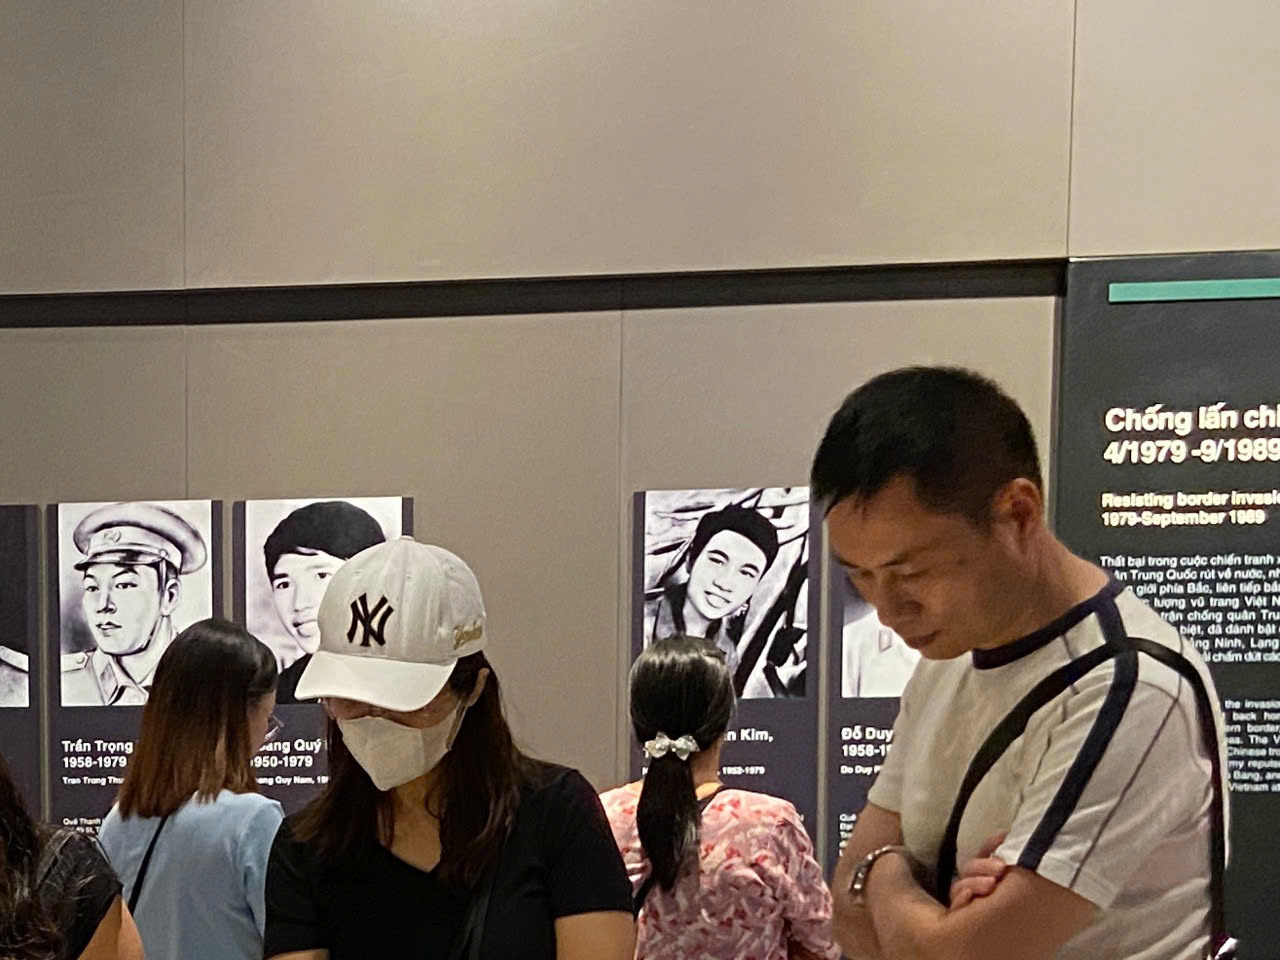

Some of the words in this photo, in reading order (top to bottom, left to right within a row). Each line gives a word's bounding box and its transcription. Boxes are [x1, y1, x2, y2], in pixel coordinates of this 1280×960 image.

[1104, 403, 1193, 436] Chống
[1198, 401, 1238, 429] lấn
[1103, 439, 1187, 464] 4/1979
[1101, 492, 1174, 510] Resisting
[1176, 491, 1230, 506] border
[346, 592, 395, 648] NY
[740, 728, 774, 743] Kim,
[864, 726, 894, 743] Duy
[94, 739, 134, 754] Trọng
[294, 738, 322, 754] Quý
[63, 755, 128, 768] 1958-1979
